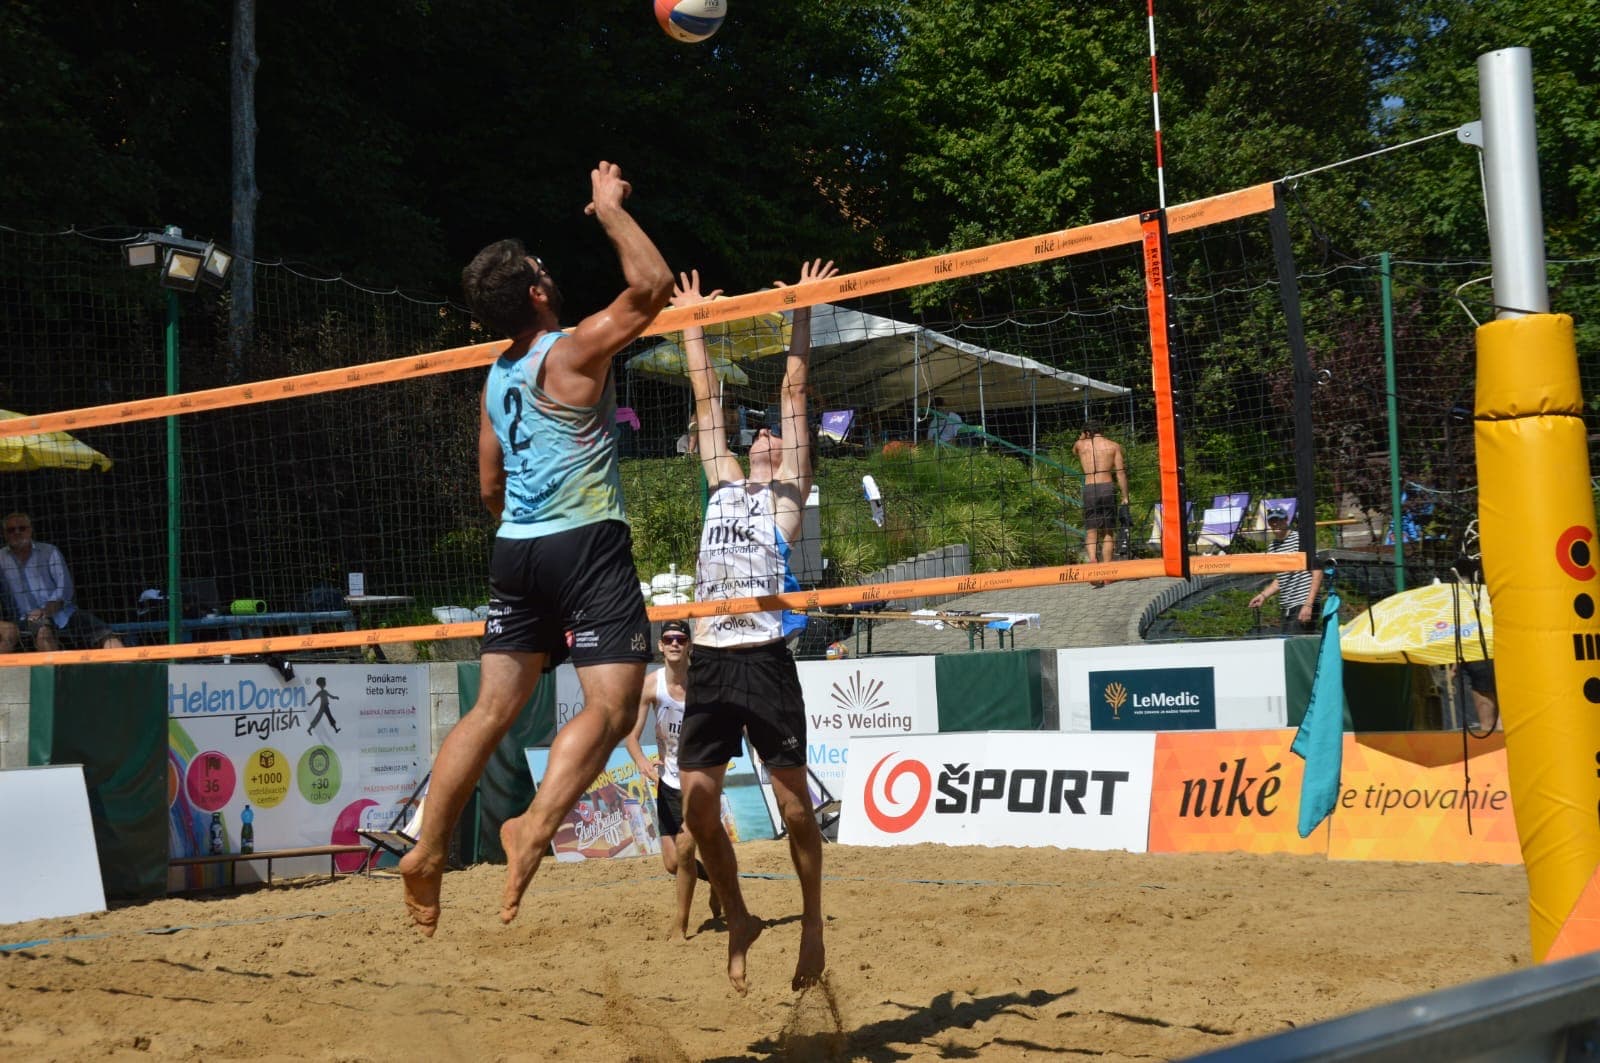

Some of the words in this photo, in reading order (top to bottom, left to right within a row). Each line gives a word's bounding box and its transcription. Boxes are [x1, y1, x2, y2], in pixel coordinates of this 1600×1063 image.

[1034, 239, 1055, 255] niké
[934, 259, 953, 275] niké
[504, 387, 531, 455] 2
[708, 518, 755, 546] niké
[1058, 568, 1080, 582] niké
[957, 578, 977, 592] niké
[714, 615, 756, 632] volley
[367, 673, 407, 684] Ponúkame
[168, 681, 235, 714] Helen
[238, 679, 306, 711] Doron
[366, 686, 384, 696] tieto
[1133, 691, 1200, 708] LeMedic
[234, 708, 301, 741] English
[811, 713, 843, 730] V+S
[847, 712, 912, 732] Welding
[204, 779, 220, 793] 36
[250, 771, 283, 785] +1000
[311, 777, 330, 790] +30
[935, 763, 1130, 816] ŠPORT
[1179, 758, 1281, 818] niké
[1340, 783, 1358, 809] e
[1365, 782, 1507, 816] tipovanie
